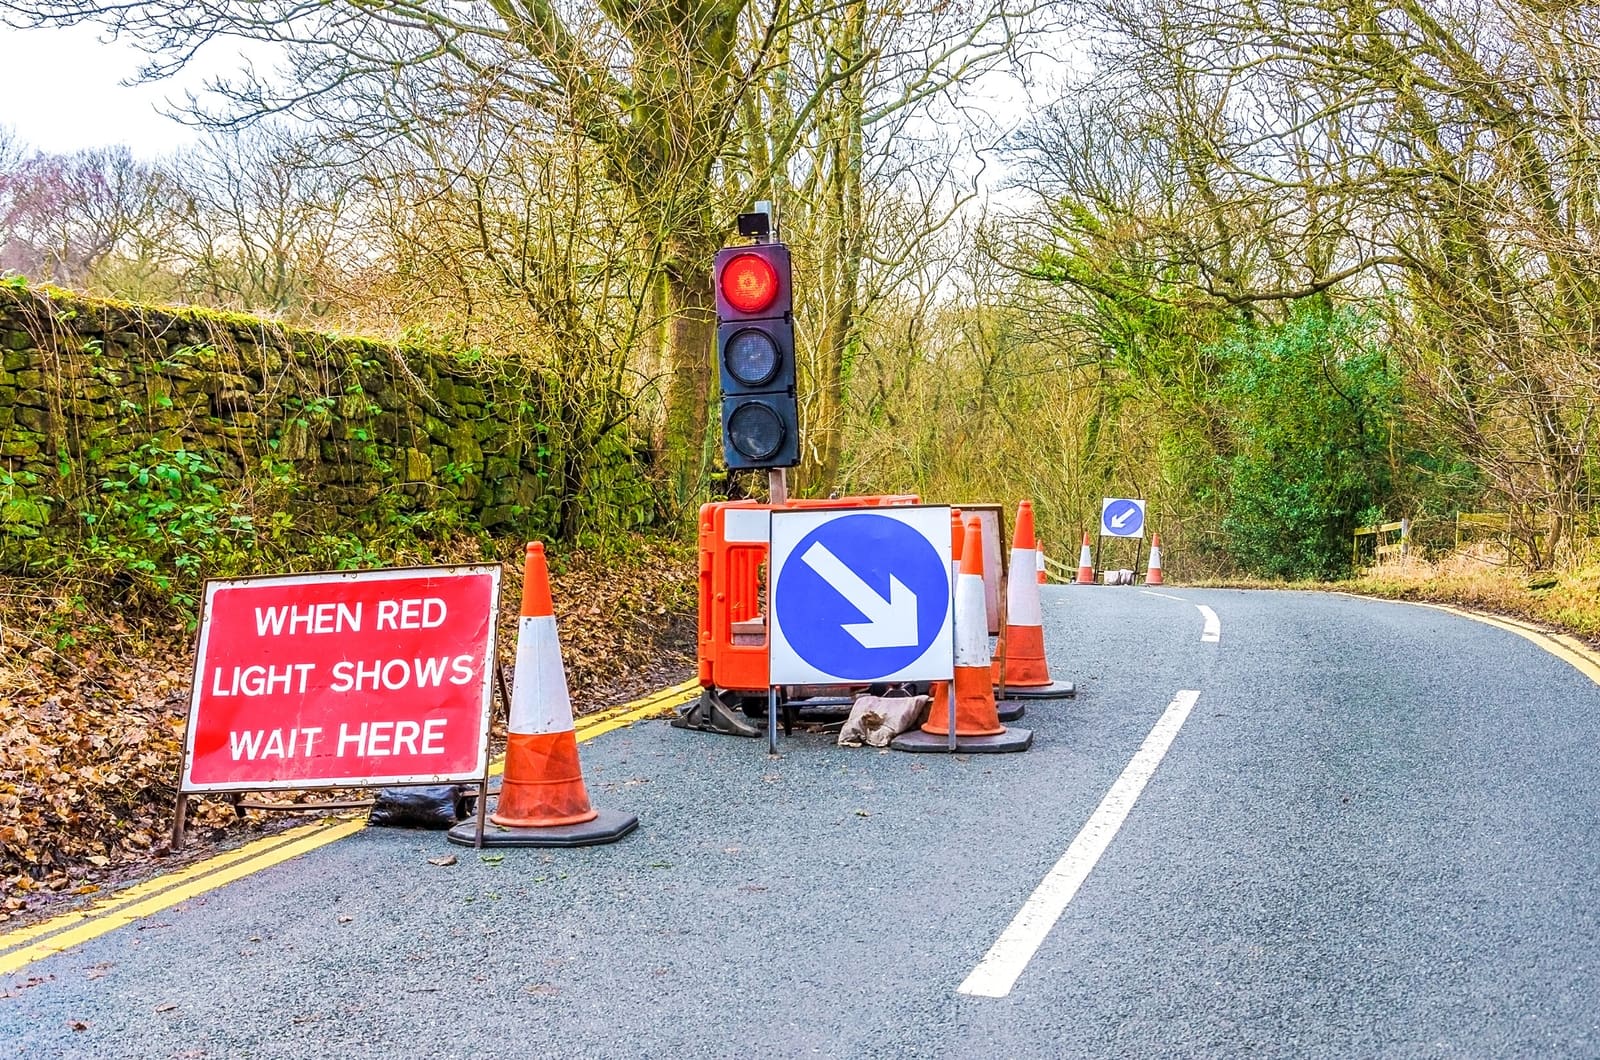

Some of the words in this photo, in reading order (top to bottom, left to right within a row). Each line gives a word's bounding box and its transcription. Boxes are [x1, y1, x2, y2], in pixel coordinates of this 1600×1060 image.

[255, 601, 362, 637] WHEN
[376, 597, 448, 631] RED
[212, 663, 315, 697] LIGHT
[330, 654, 474, 693] SHOWS
[229, 726, 323, 761] WAIT
[336, 718, 448, 758] HERE
